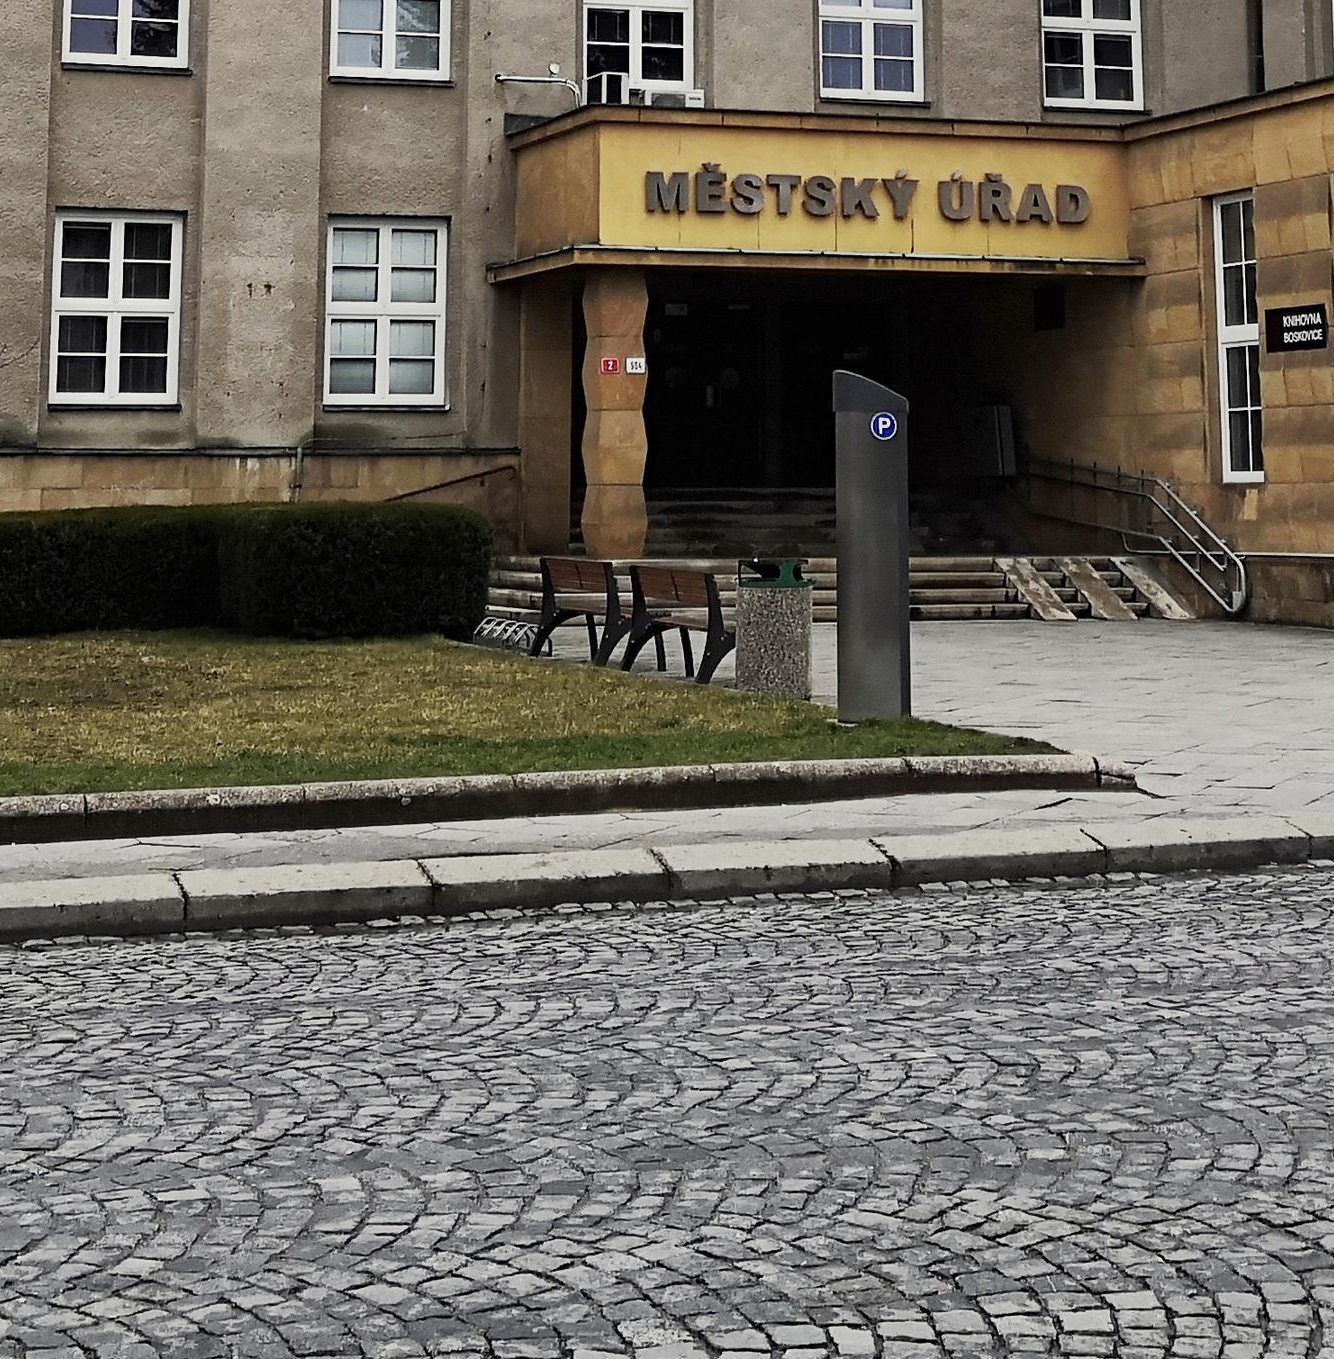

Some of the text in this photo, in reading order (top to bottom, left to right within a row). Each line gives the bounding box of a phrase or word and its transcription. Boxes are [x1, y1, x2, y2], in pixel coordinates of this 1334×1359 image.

[644, 163, 1091, 225] MĚSTSKÝ ÚŘAD
[1282, 312, 1322, 328] KNIHOVNA
[1283, 329, 1324, 343] BOSKOVICE
[607, 360, 614, 371] 2
[878, 416, 891, 435] P
